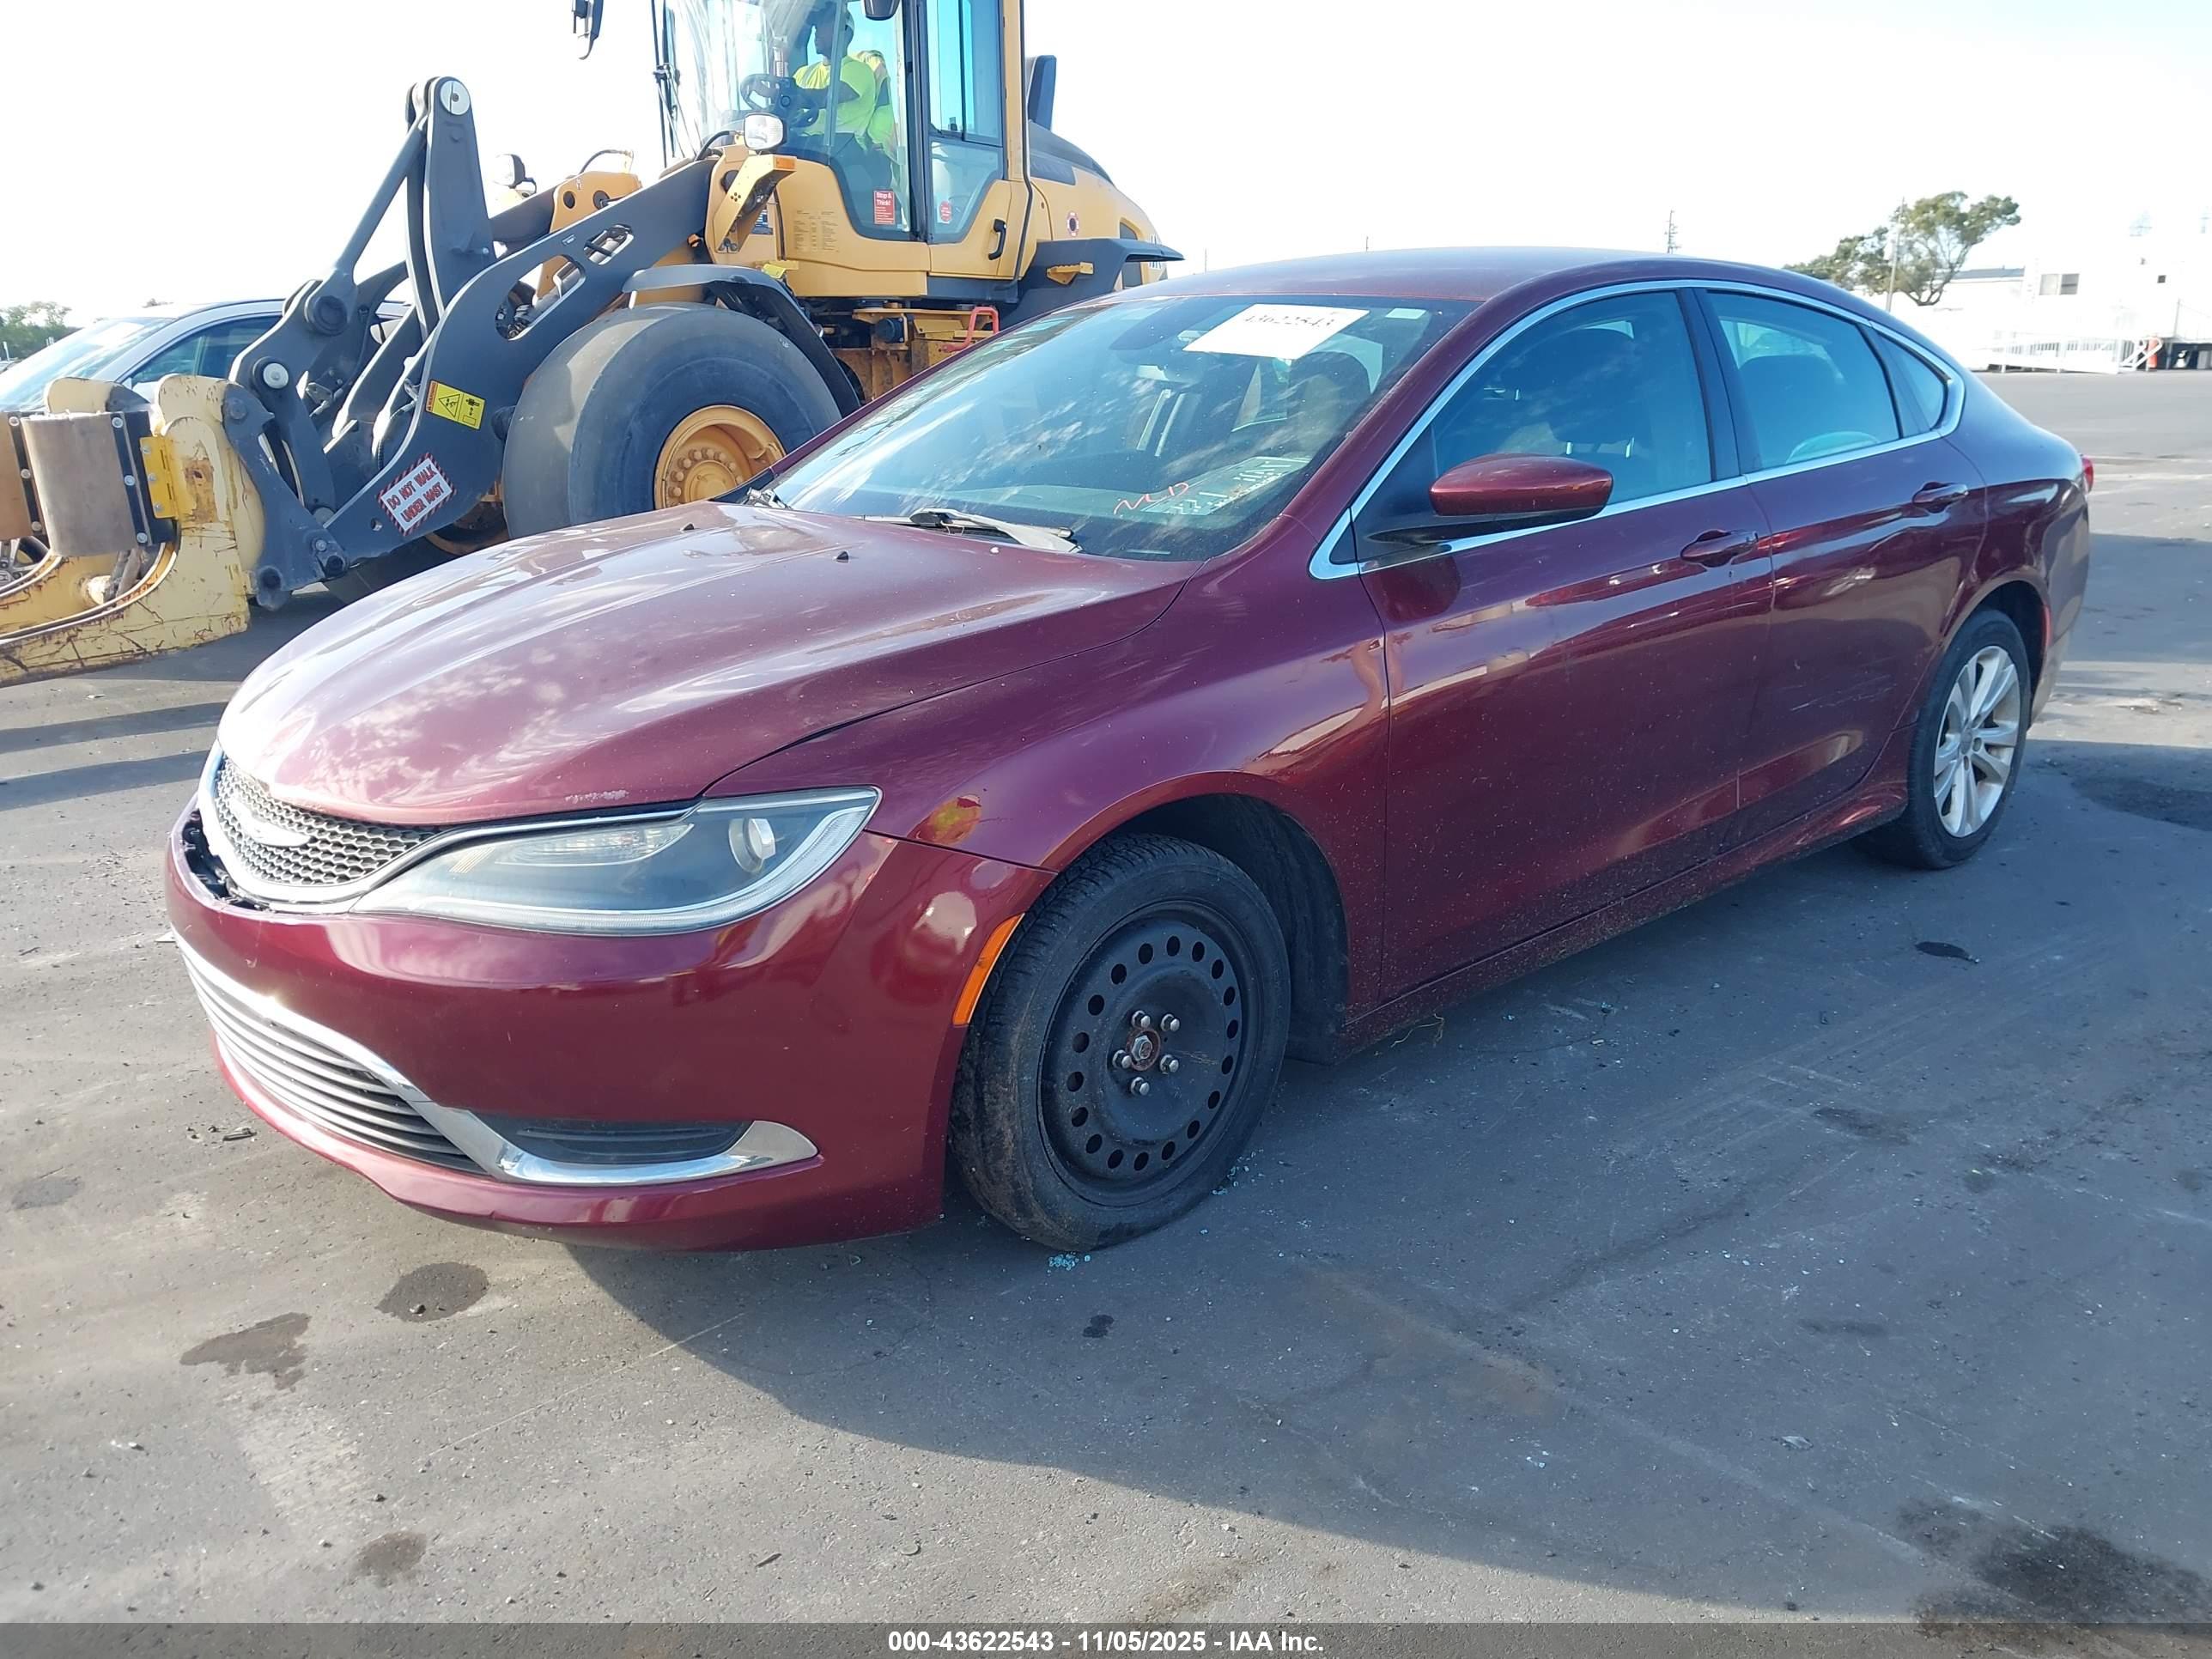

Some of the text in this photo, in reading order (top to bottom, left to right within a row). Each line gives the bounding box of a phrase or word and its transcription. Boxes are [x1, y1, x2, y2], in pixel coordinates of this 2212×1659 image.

[386, 465, 438, 510] DO NOT WALK
[400, 498, 427, 522] UNDER
